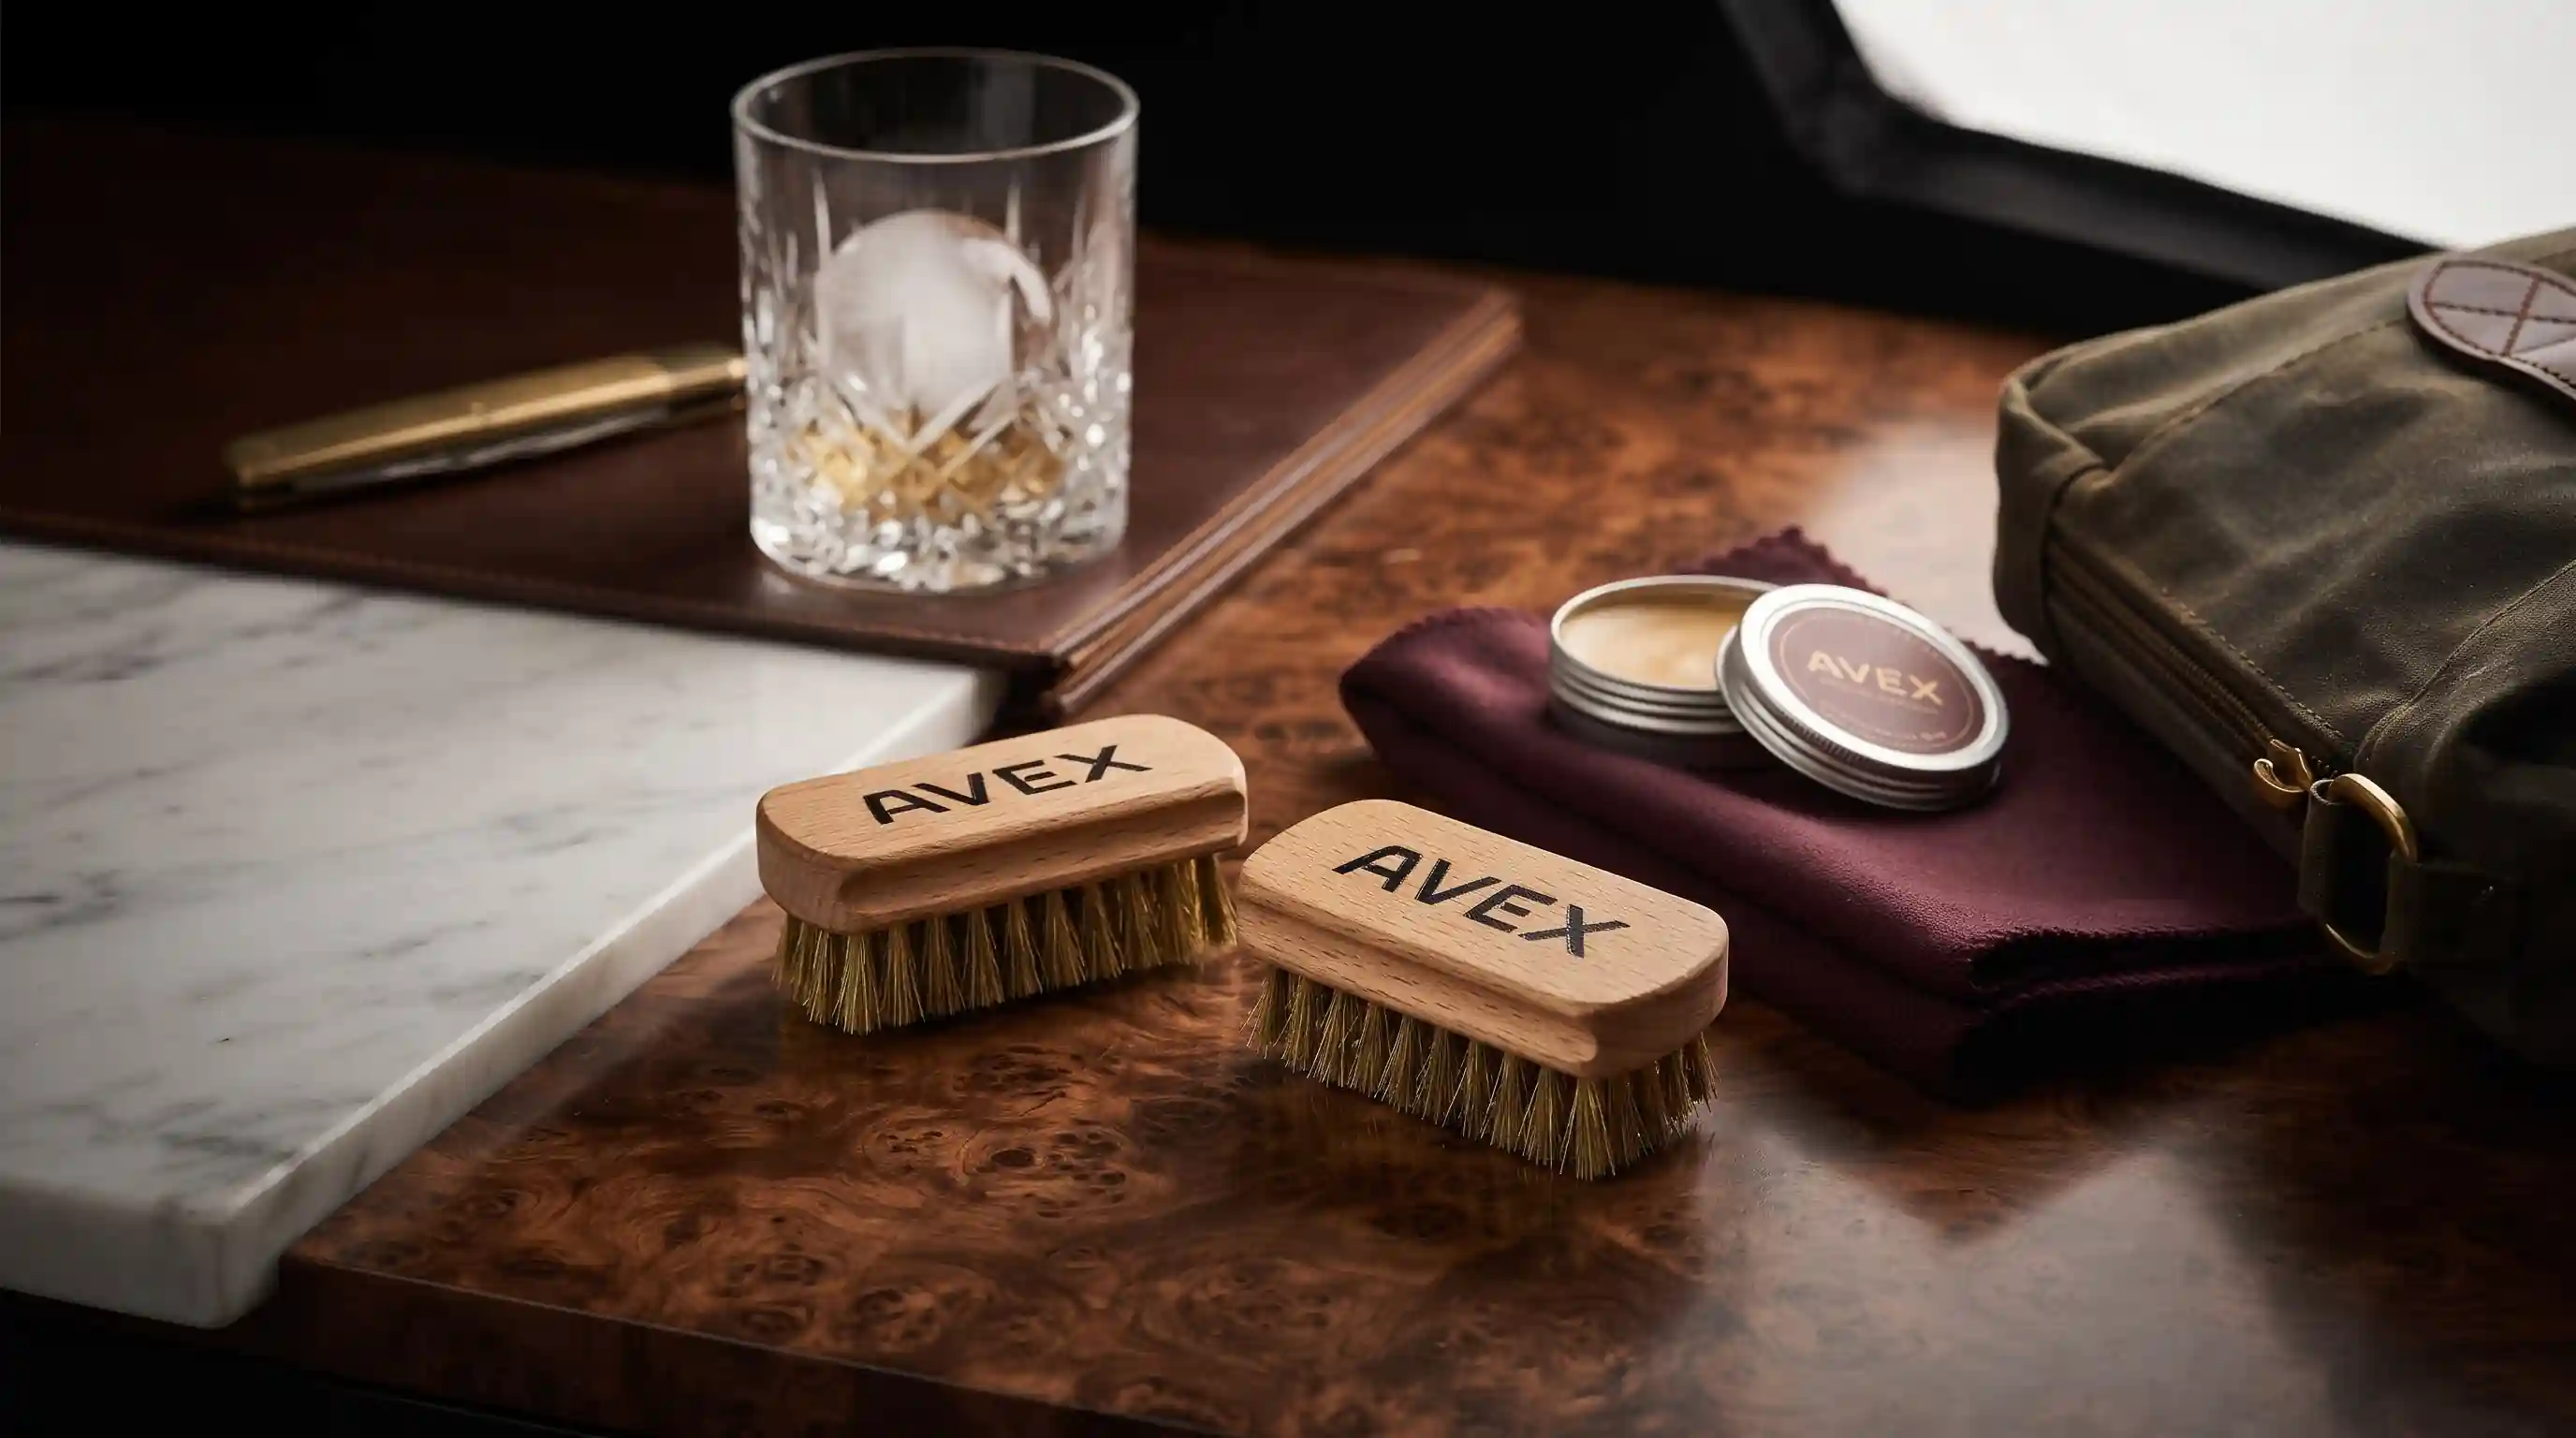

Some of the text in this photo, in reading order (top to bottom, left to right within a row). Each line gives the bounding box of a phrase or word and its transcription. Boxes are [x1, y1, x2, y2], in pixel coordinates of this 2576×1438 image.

[1807, 650, 1943, 706] AVEX
[863, 744, 1152, 825] AVEX
[1332, 844, 1631, 959] AVEX
